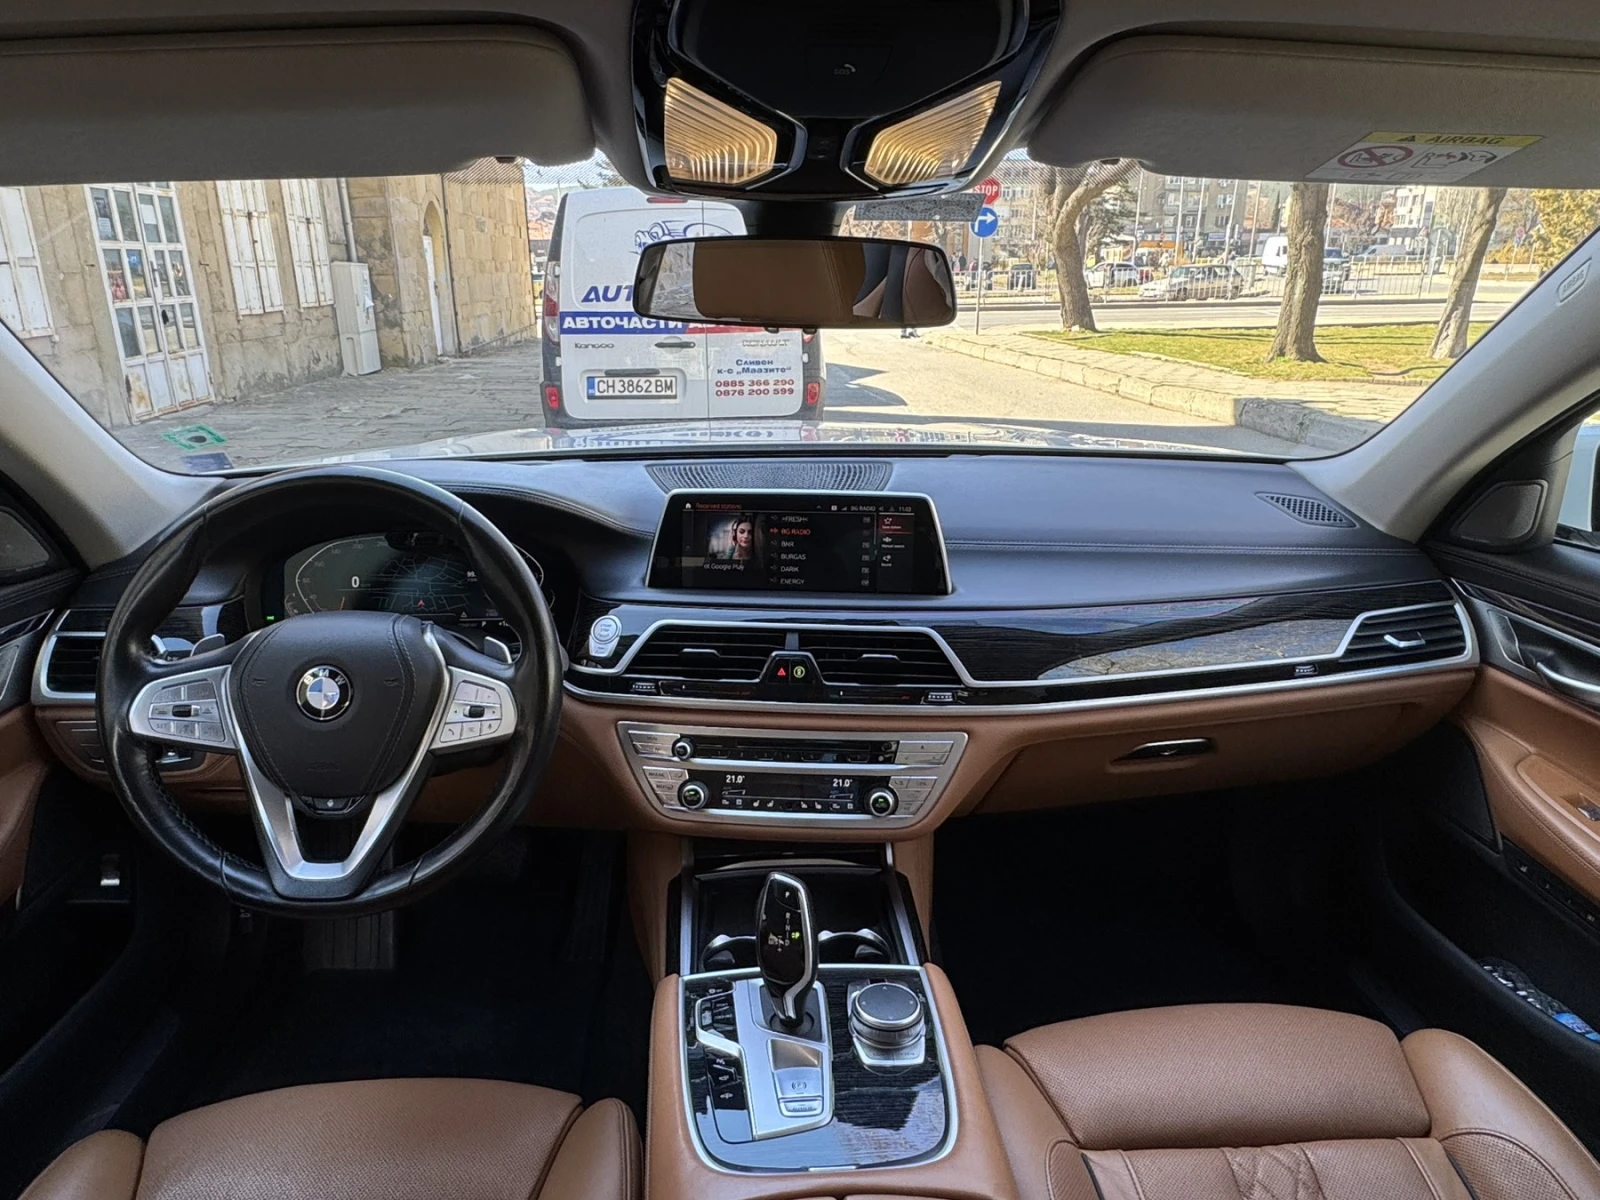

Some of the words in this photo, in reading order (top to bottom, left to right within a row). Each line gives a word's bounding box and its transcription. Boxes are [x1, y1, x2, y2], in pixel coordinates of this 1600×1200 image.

[1426, 135, 1505, 146] AIRBAG
[974, 186, 999, 194] STOP
[562, 316, 683, 329] АВТОЧАСТИ
[748, 388, 770, 396] 200
[791, 528, 811, 536] RADIO
[351, 576, 360, 588] 0
[303, 668, 346, 686] BMW
